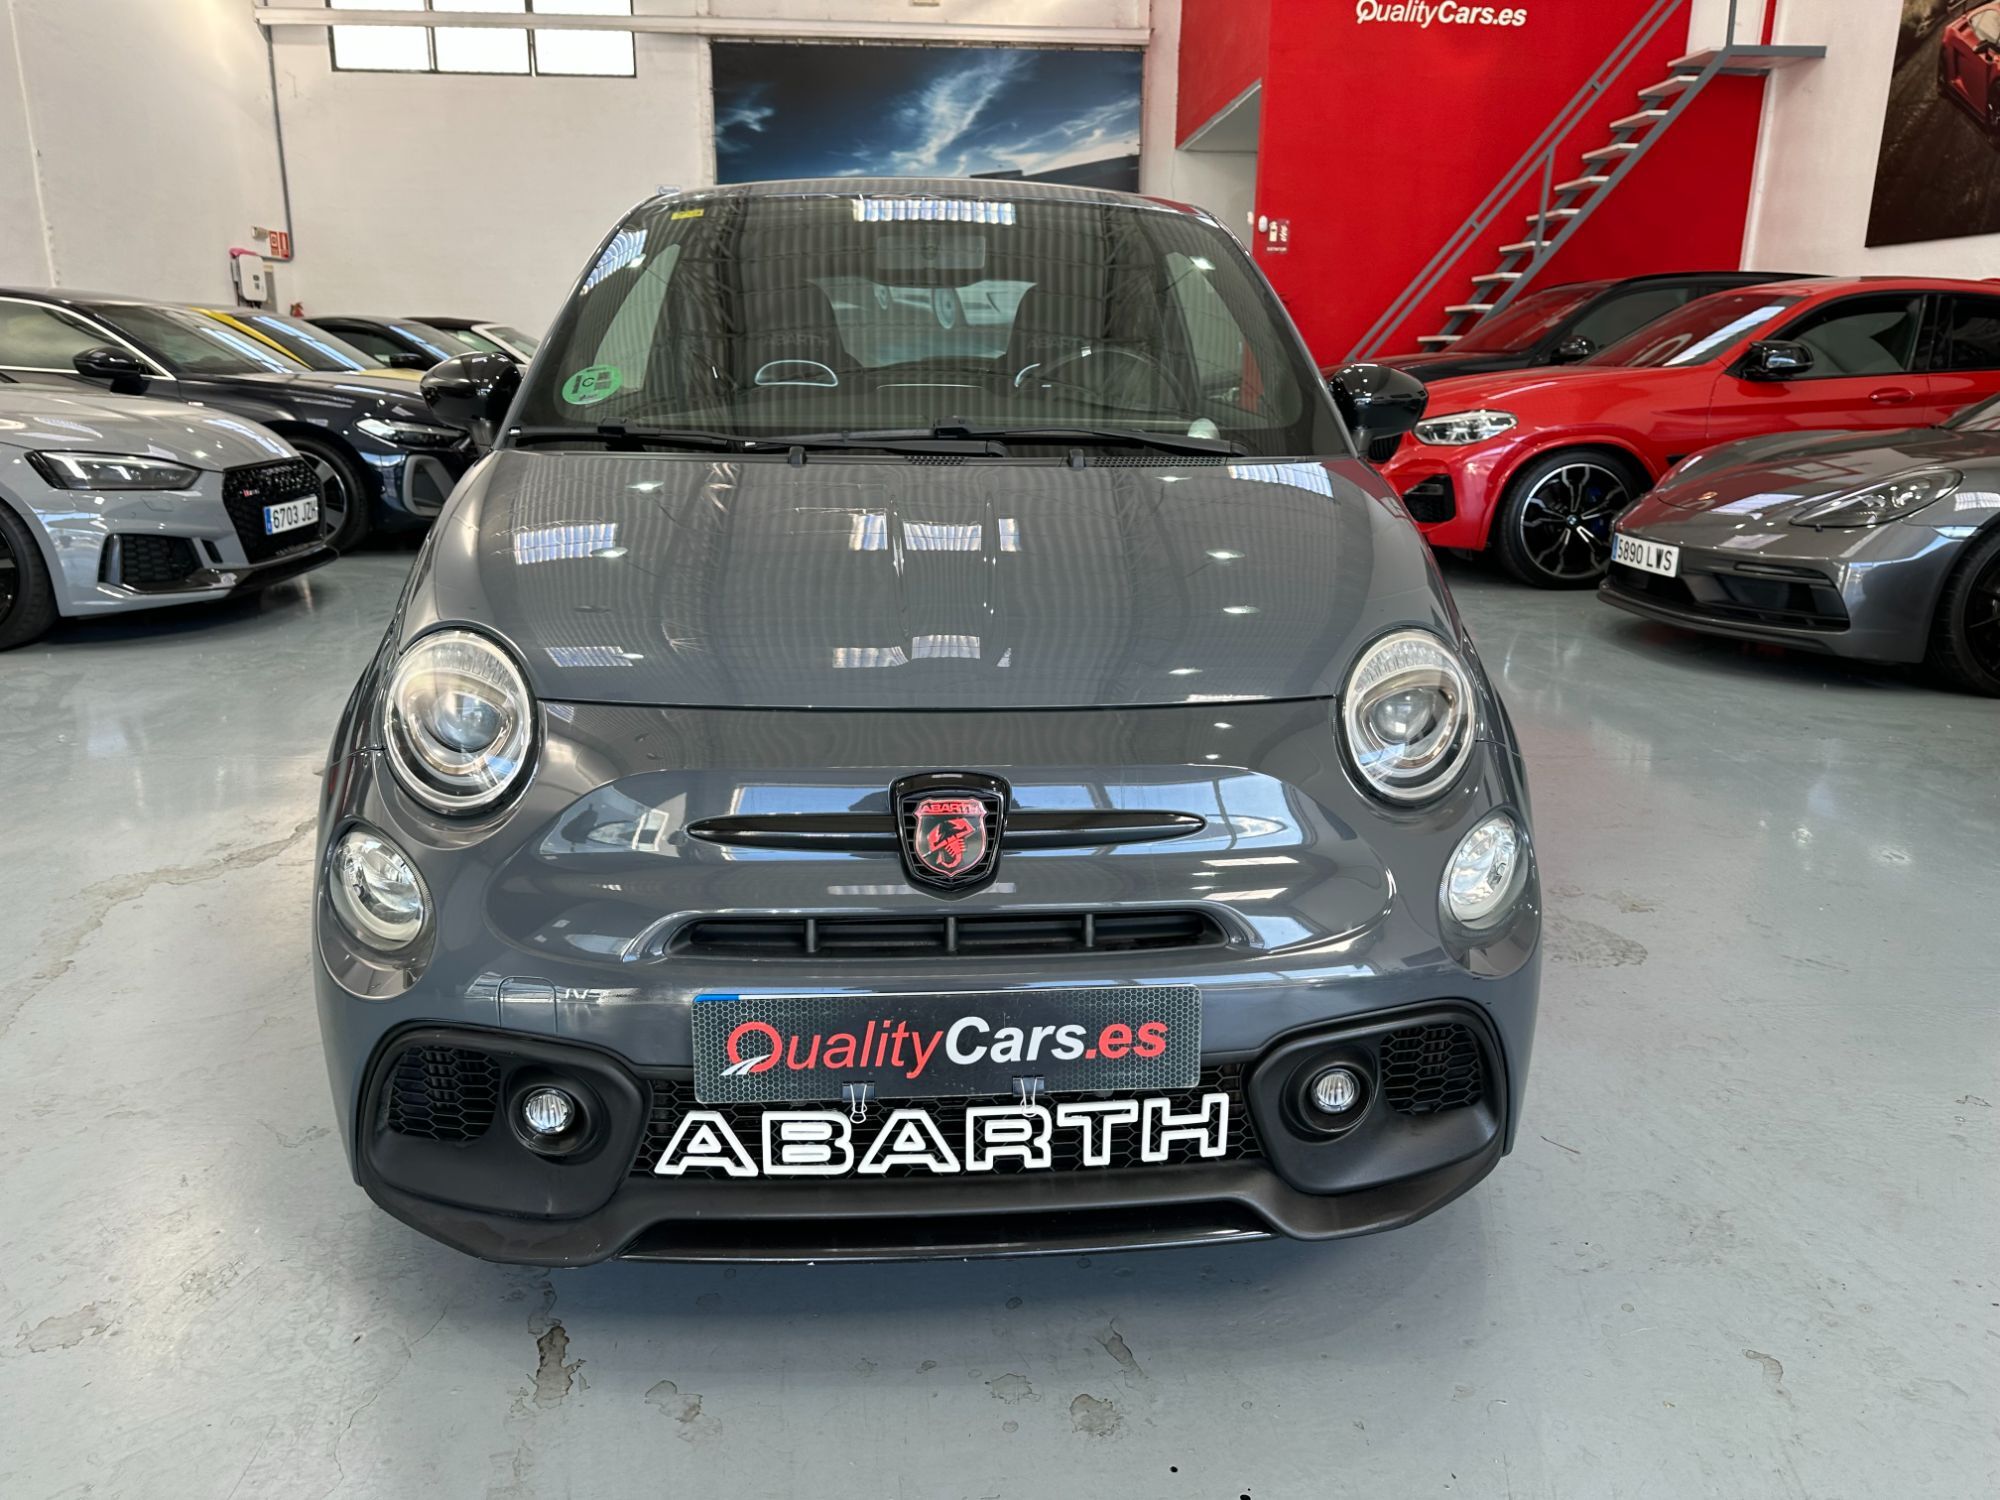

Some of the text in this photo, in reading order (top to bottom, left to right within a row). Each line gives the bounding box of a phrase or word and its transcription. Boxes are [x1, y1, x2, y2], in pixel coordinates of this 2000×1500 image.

[1356, 0, 1527, 29] QualityCars.es
[273, 505, 299, 529] 6703
[1618, 539, 1643, 564] 5890
[921, 802, 979, 814] ABARTH
[719, 1016, 1168, 1079] QualityCars.es
[654, 1092, 1229, 1177] ABARTH
